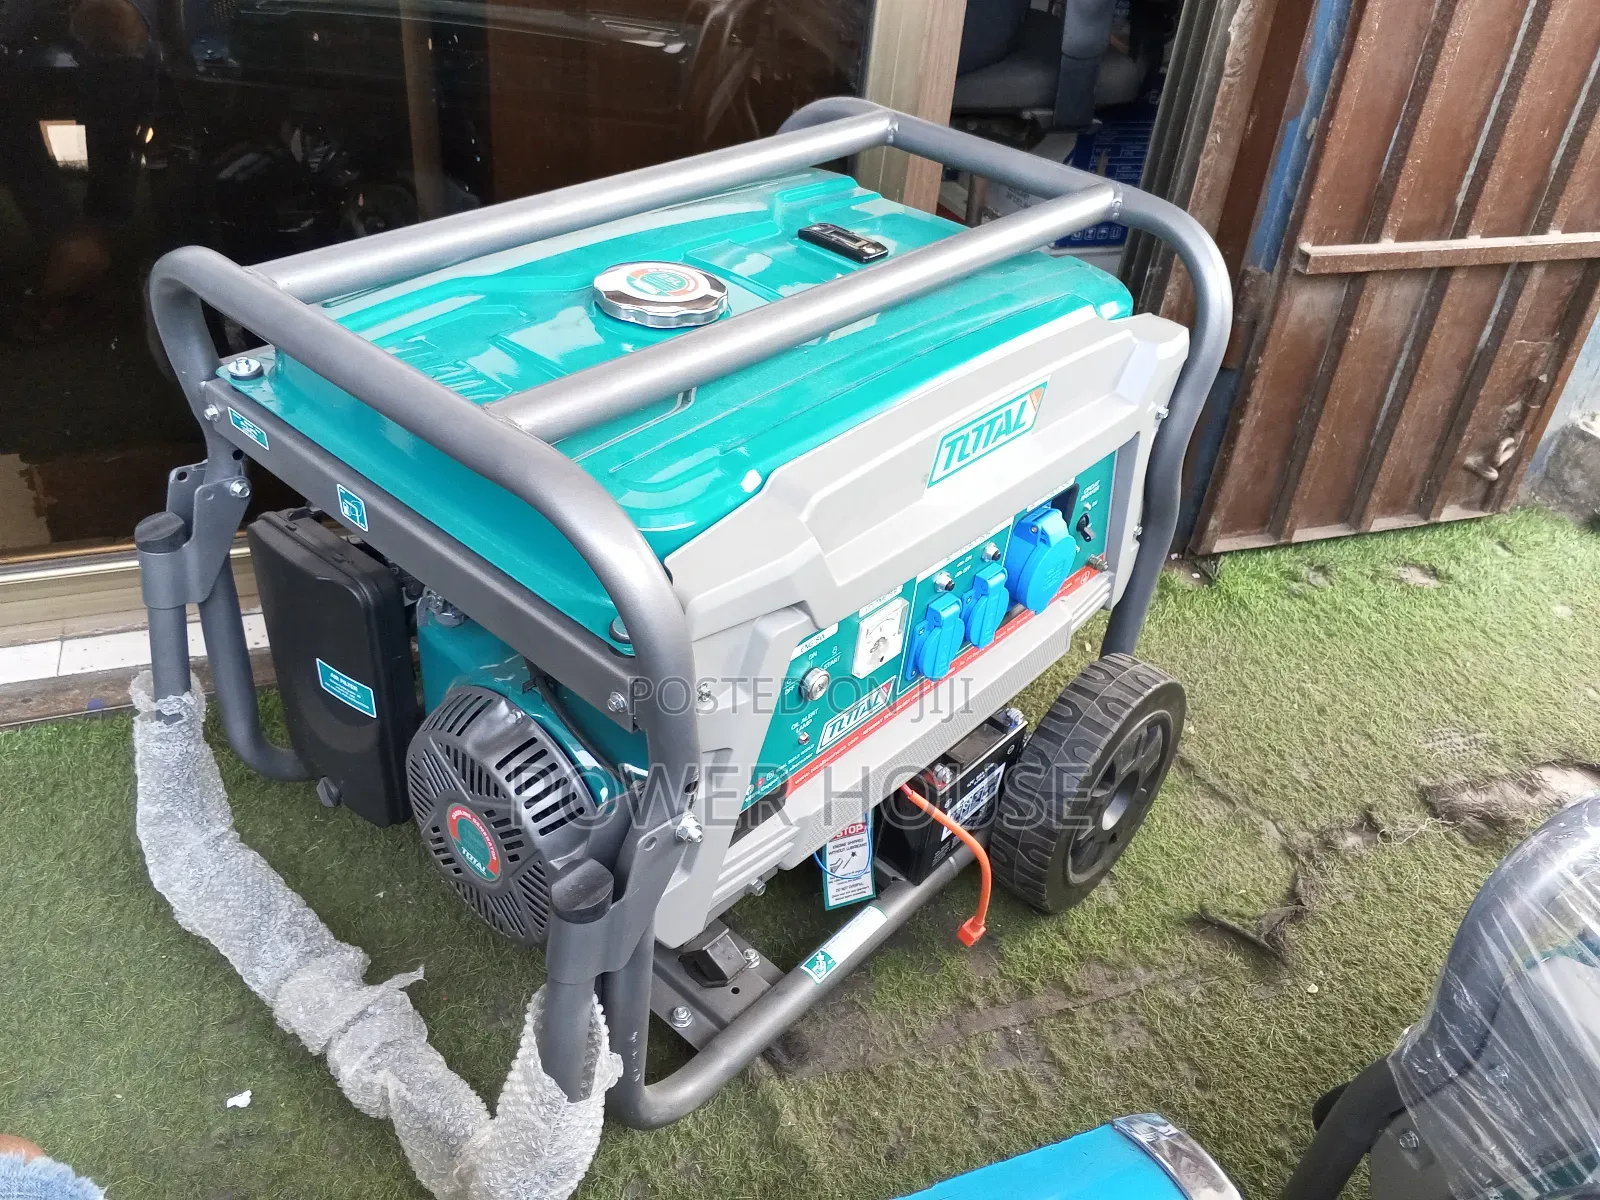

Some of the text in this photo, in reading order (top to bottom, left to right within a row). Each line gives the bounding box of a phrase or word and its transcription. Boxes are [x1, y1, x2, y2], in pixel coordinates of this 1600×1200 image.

[808, 650, 818, 660] ON
[823, 655, 841, 670] START
[784, 684, 796, 696] OFF
[461, 846, 487, 873] TOTAL
